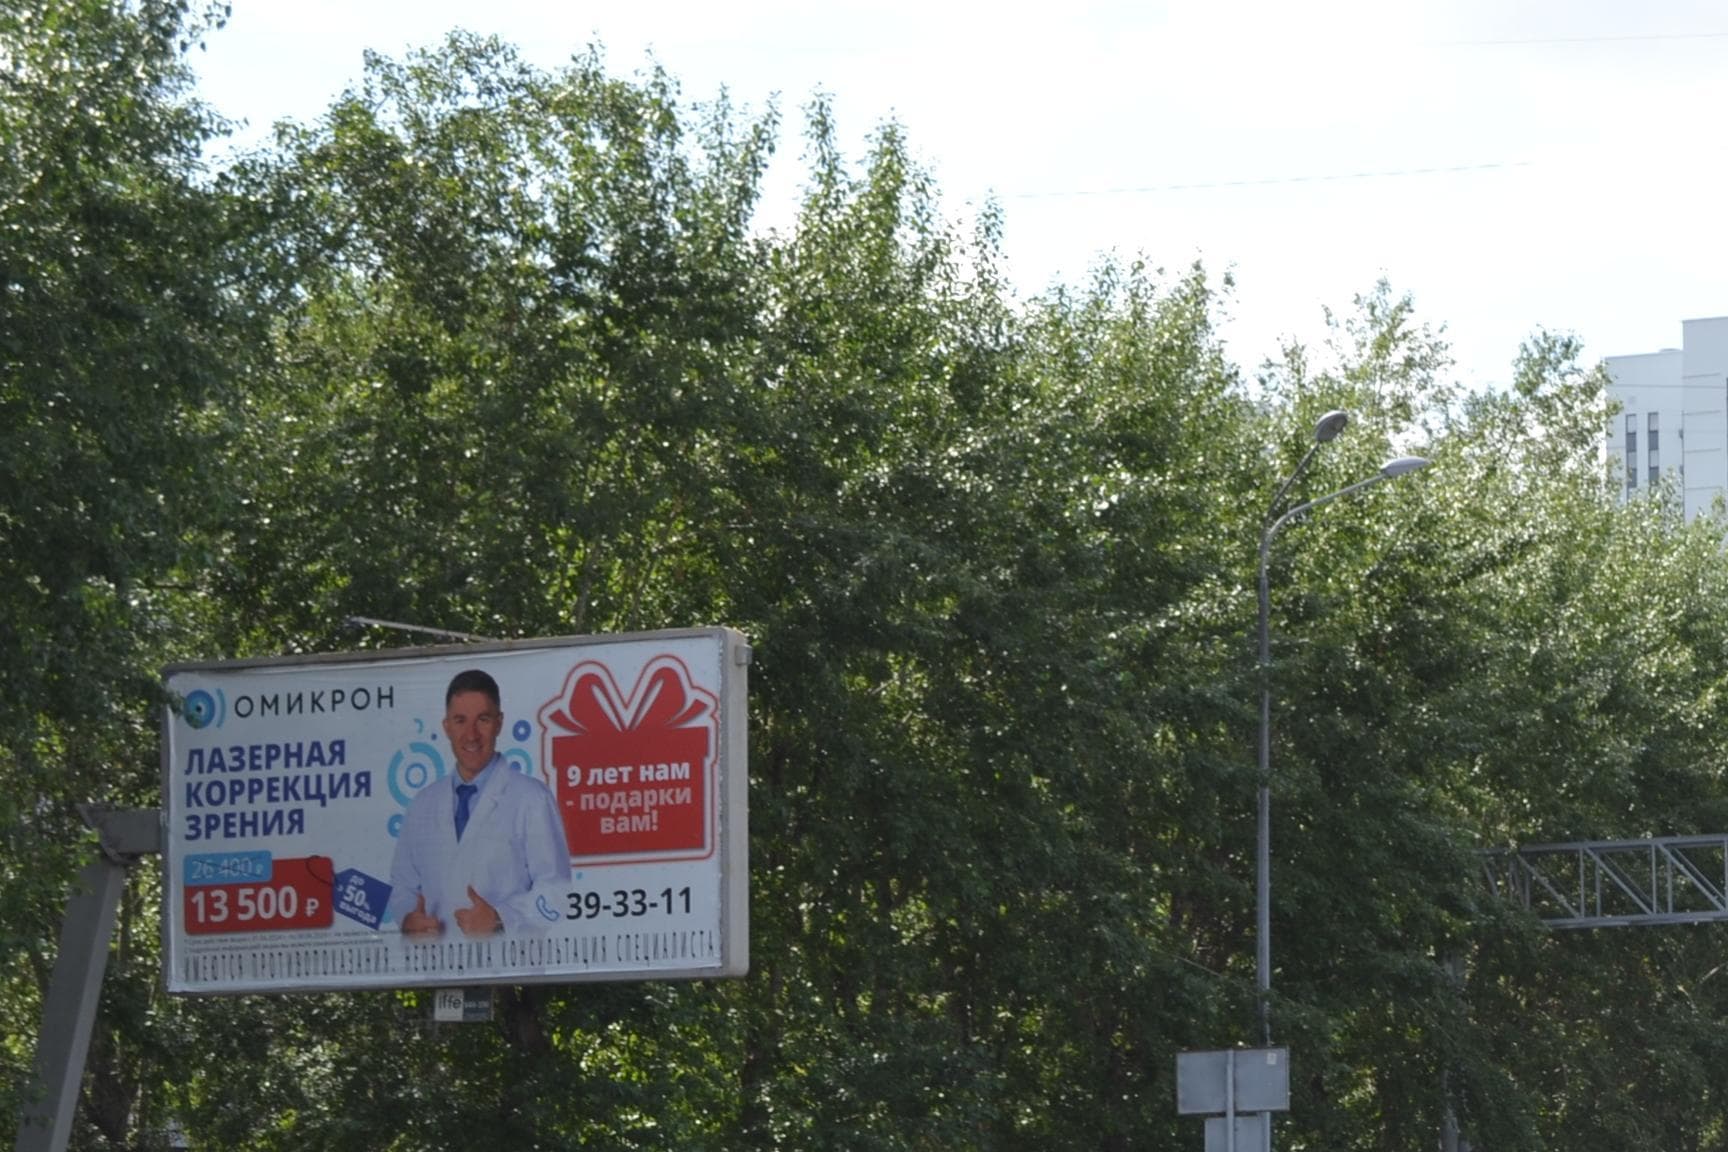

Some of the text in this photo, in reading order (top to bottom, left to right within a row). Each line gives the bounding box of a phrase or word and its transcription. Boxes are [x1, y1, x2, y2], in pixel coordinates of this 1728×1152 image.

[234, 685, 395, 719] ОМИКРОН
[184, 739, 346, 776] ЛАЗЕРНАЯ
[567, 762, 691, 787] 9 лет нам
[185, 771, 372, 808] КОРРЕКЦИЯ
[580, 787, 692, 814] подарки
[184, 808, 305, 841] ЗРЕНИЯ
[600, 810, 659, 834] вам!
[191, 889, 229, 923] 13
[237, 886, 299, 921] 500
[566, 886, 691, 920] 39-33-11
[184, 953, 243, 982] ИМЕЮТСЯ
[404, 941, 493, 974] НЕОБХОДИМА
[502, 935, 607, 969] КОНСУЛЬТАЦИЯ
[616, 930, 714, 963] СПЕЦИАЛИСТА
